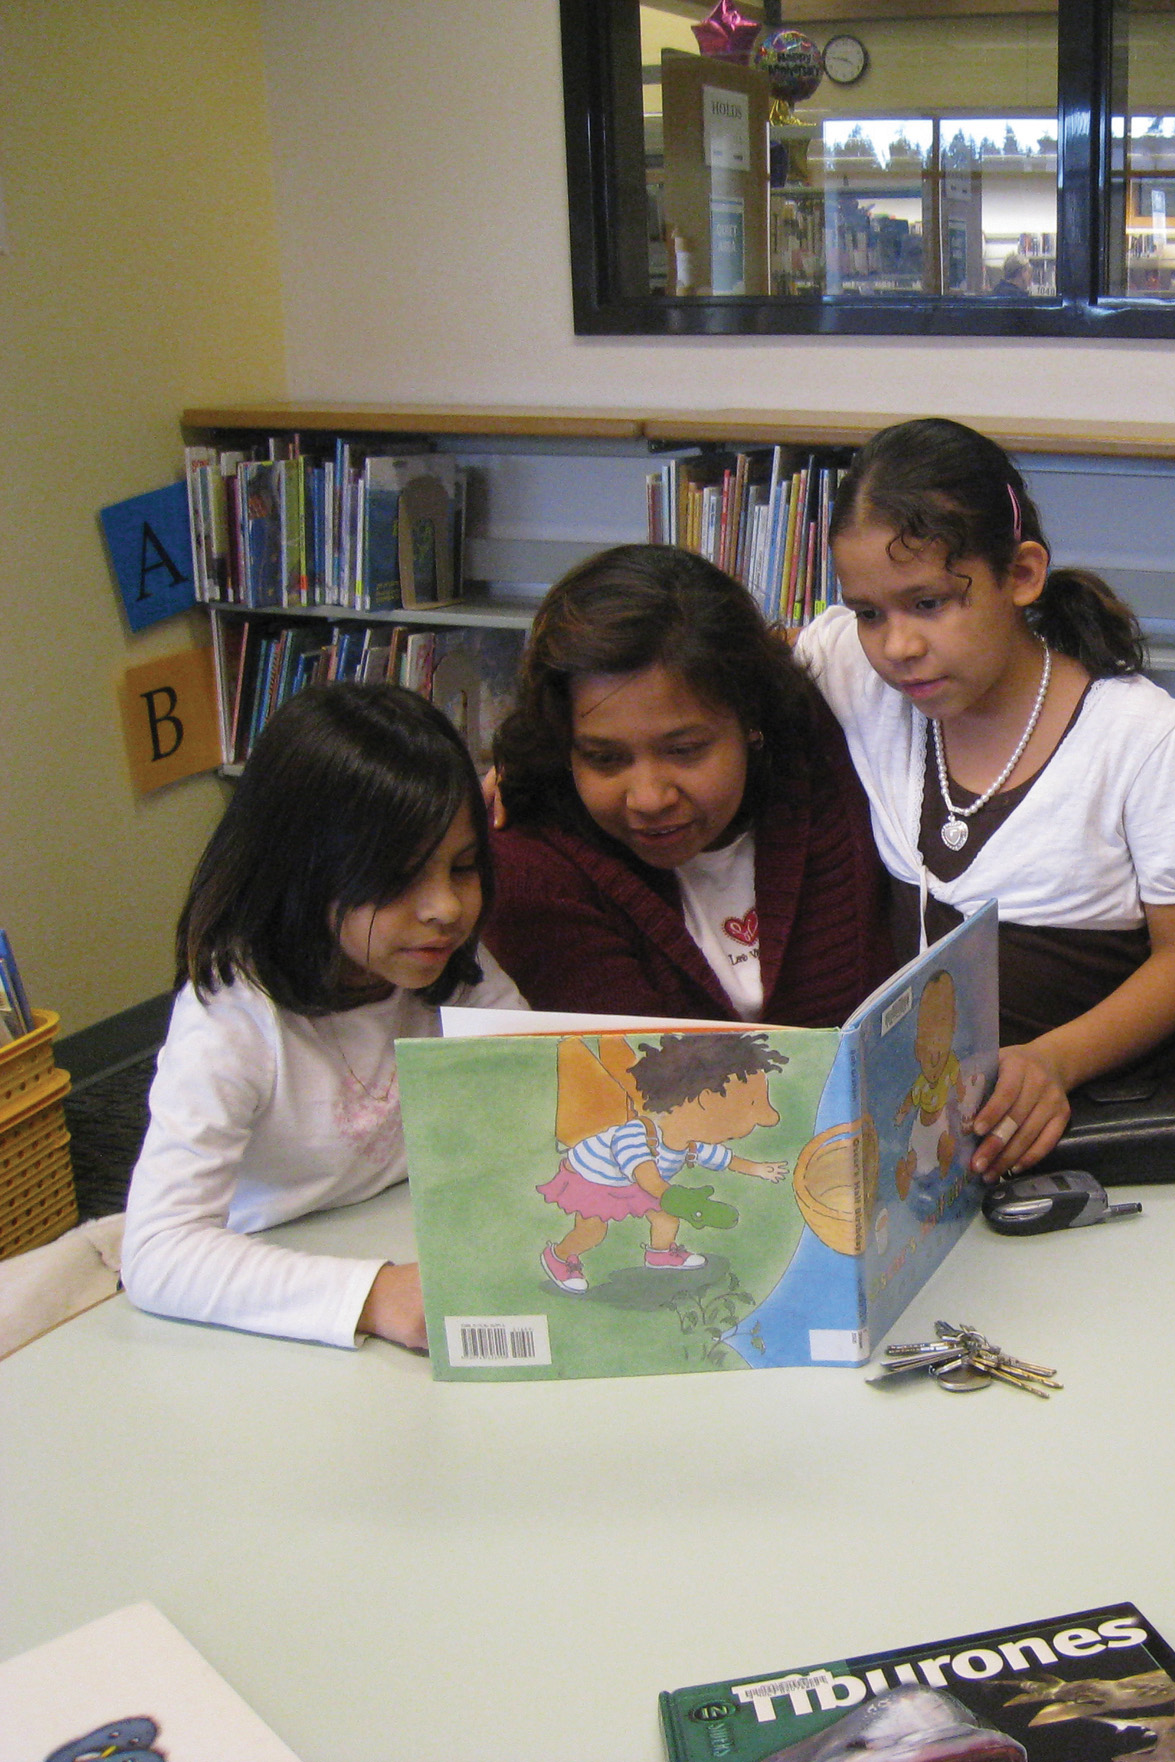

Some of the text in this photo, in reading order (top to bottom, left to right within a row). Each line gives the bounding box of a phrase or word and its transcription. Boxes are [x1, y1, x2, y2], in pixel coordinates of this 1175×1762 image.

[711, 101, 743, 119] HOLDS
[135, 520, 190, 602] A
[140, 686, 184, 762] B
[731, 1616, 1148, 1723] Tiburones
